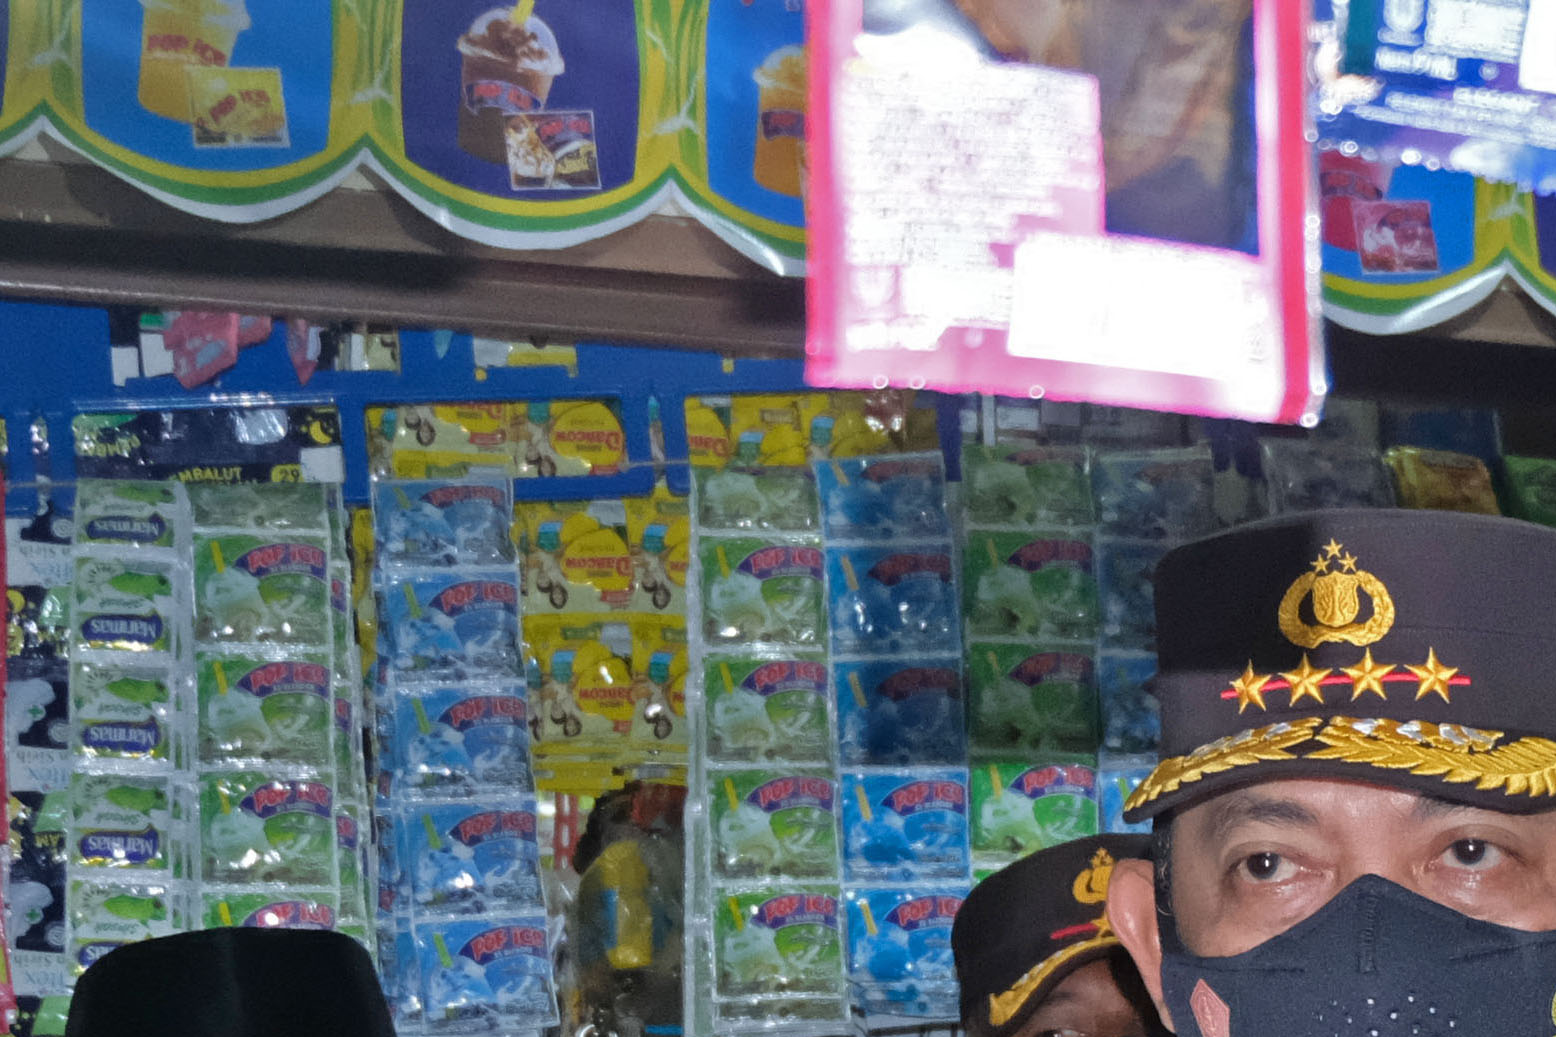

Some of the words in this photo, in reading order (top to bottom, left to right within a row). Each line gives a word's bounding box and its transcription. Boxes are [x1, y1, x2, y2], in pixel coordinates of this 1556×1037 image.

[88, 618, 157, 637] Marimas
[88, 725, 156, 749] Marimas
[893, 783, 930, 811] POP
[898, 899, 932, 926] POP
